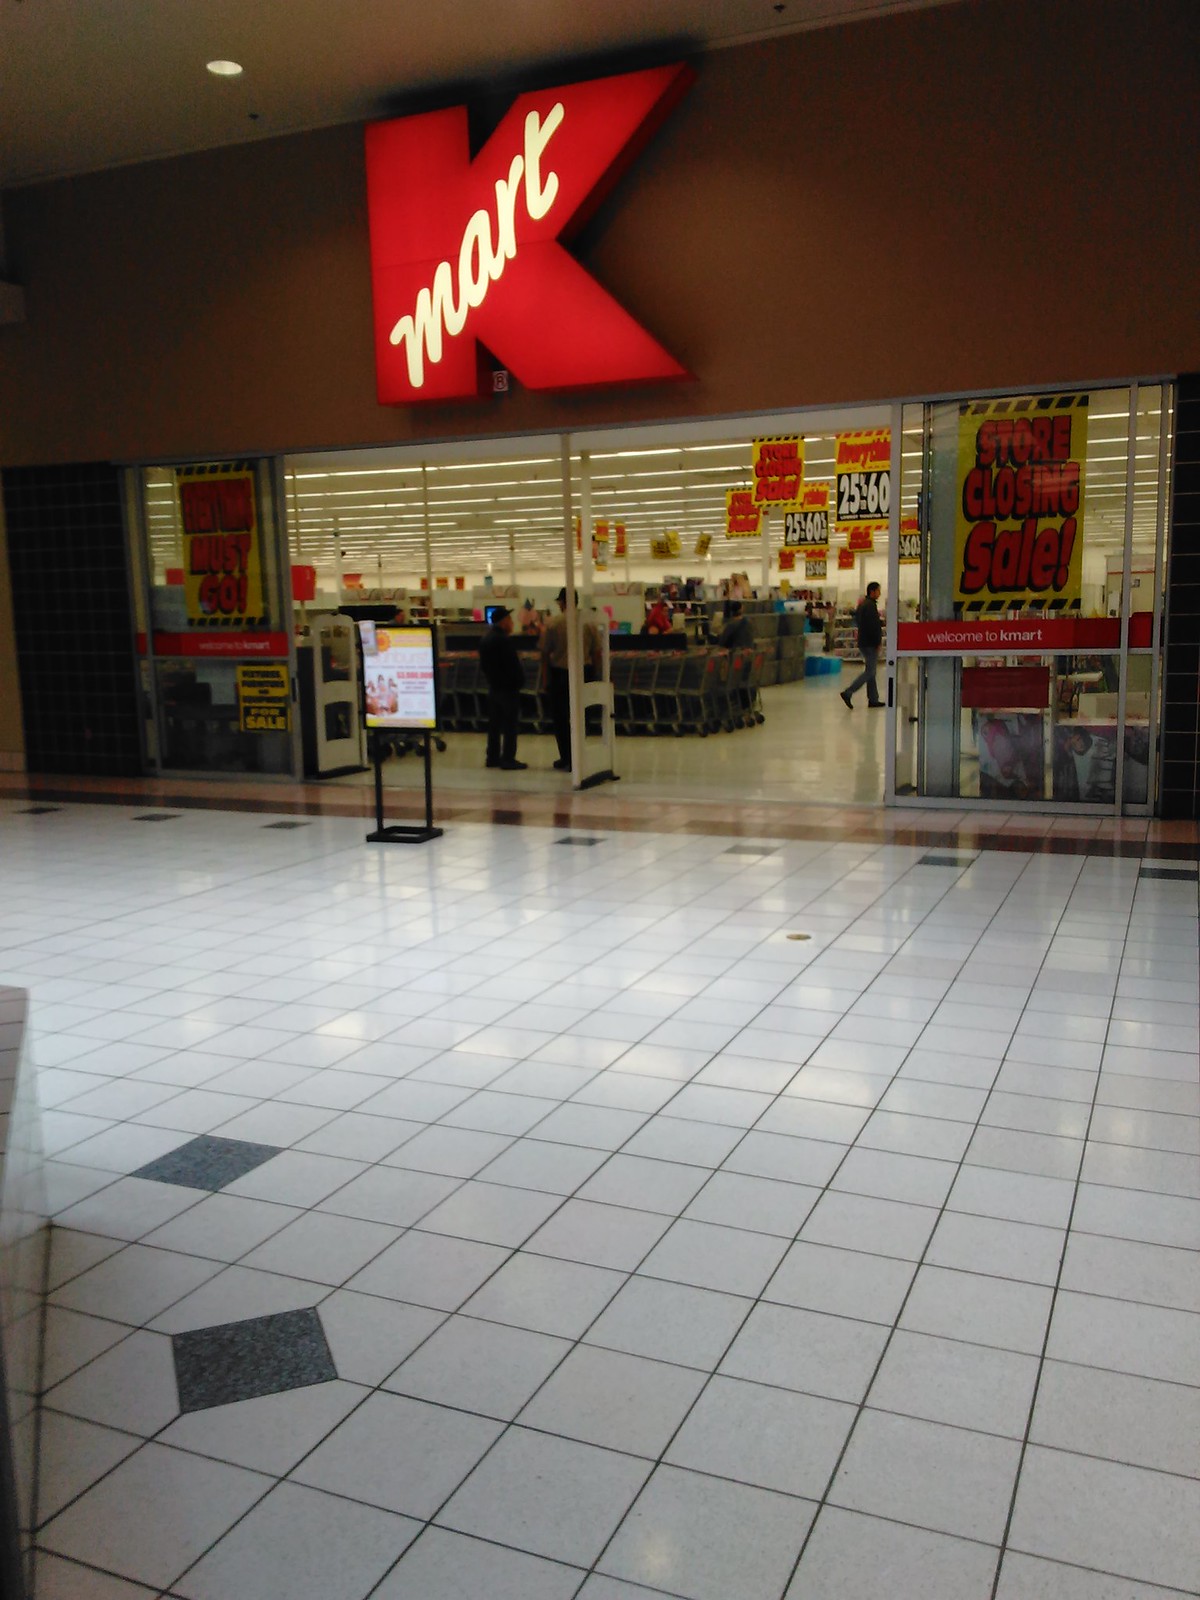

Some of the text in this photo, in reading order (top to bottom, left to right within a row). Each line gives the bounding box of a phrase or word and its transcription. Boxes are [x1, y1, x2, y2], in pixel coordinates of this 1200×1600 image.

[365, 61, 696, 405] K
[390, 102, 565, 388] mart
[975, 414, 1071, 468] STORE
[963, 461, 1080, 522] CLOSING
[190, 533, 251, 575] MUST
[960, 516, 1077, 594] Sale!
[199, 573, 248, 615] GO!
[199, 641, 234, 650] welcome
[244, 640, 271, 650] kmart
[927, 629, 1043, 643] welcome to kmart
[245, 716, 286, 729] SALE
